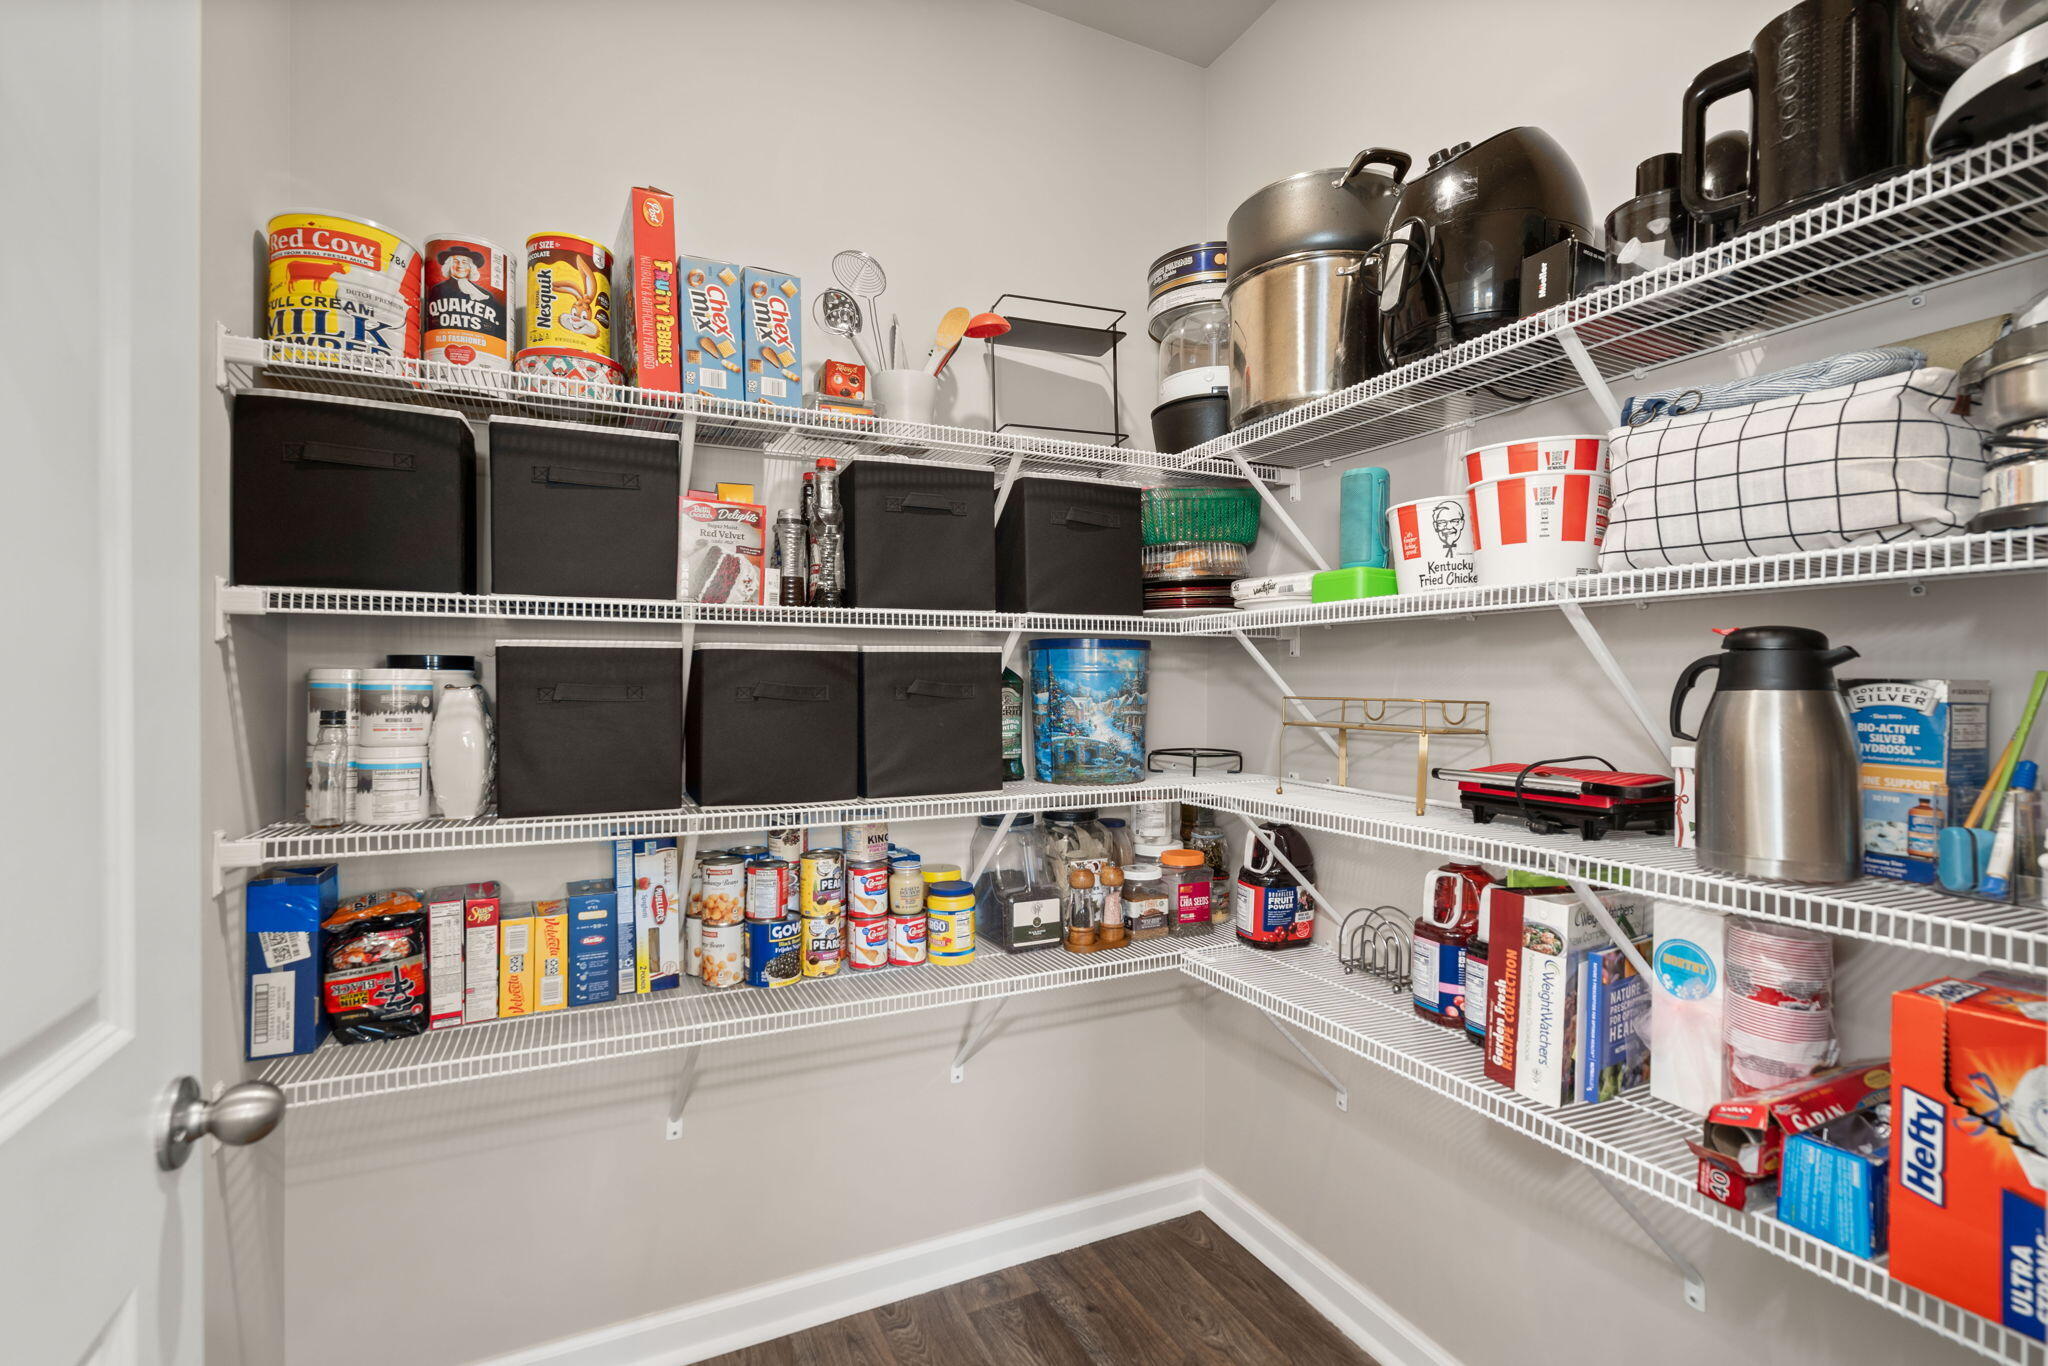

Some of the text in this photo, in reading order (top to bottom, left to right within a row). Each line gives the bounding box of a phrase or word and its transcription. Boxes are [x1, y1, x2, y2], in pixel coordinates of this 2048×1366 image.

[646, 202, 660, 223] Post
[270, 229, 379, 260] Red Cow
[539, 241, 555, 249] SIZE
[303, 250, 321, 258] REAL
[323, 252, 348, 261] FRESH
[349, 257, 370, 266] MILK
[388, 253, 407, 269] 786
[640, 255, 652, 290] NATURALLY
[346, 289, 371, 300] DUTCH
[537, 269, 557, 328] Nesquik
[300, 295, 375, 317] CREAM
[642, 296, 653, 336] ARTIFICIALLY
[690, 290, 716, 334] mix
[706, 286, 734, 339] Chex
[267, 308, 393, 350] MILK
[440, 313, 482, 330] OATS
[753, 301, 778, 344] mix
[768, 296, 794, 349] Chex
[448, 335, 487, 347] FASHIONED
[655, 314, 675, 367] PEBBLES
[643, 337, 655, 369] FLAVORED
[718, 508, 759, 523] Delights
[700, 528, 745, 540] Red Velvet
[1427, 559, 1474, 575] Kentucky
[1419, 571, 1478, 588] Fried Chicke
[1852, 686, 1929, 696] SOVEREIGN
[1856, 694, 1926, 705] SILVER
[1857, 722, 1920, 735] BIO-ACTIVE
[1869, 733, 1906, 745] SILVER
[1180, 896, 1209, 907] CHIA SEEDS
[1268, 896, 1295, 905] FRUIT
[928, 919, 946, 932] RGO
[544, 919, 560, 956] Velveeta
[331, 979, 376, 996] BLACK
[373, 965, 415, 1011] 辛
[508, 974, 525, 1014] Velveeta
[339, 997, 369, 1007] SHIN
[1502, 948, 1518, 1071] RECIPE COLLECTION
[1492, 979, 1507, 1066] Garden Fresh
[1538, 971, 1555, 1066] WeightWatchers
[1609, 1013, 1622, 1026] FOR
[1719, 1105, 1752, 1114] SARAN
[1790, 1103, 1847, 1131] SARAN
[1907, 1100, 1945, 1196] Hefty
[1709, 1168, 1731, 1201] 40
[2010, 1243, 2035, 1319] ULTRA
